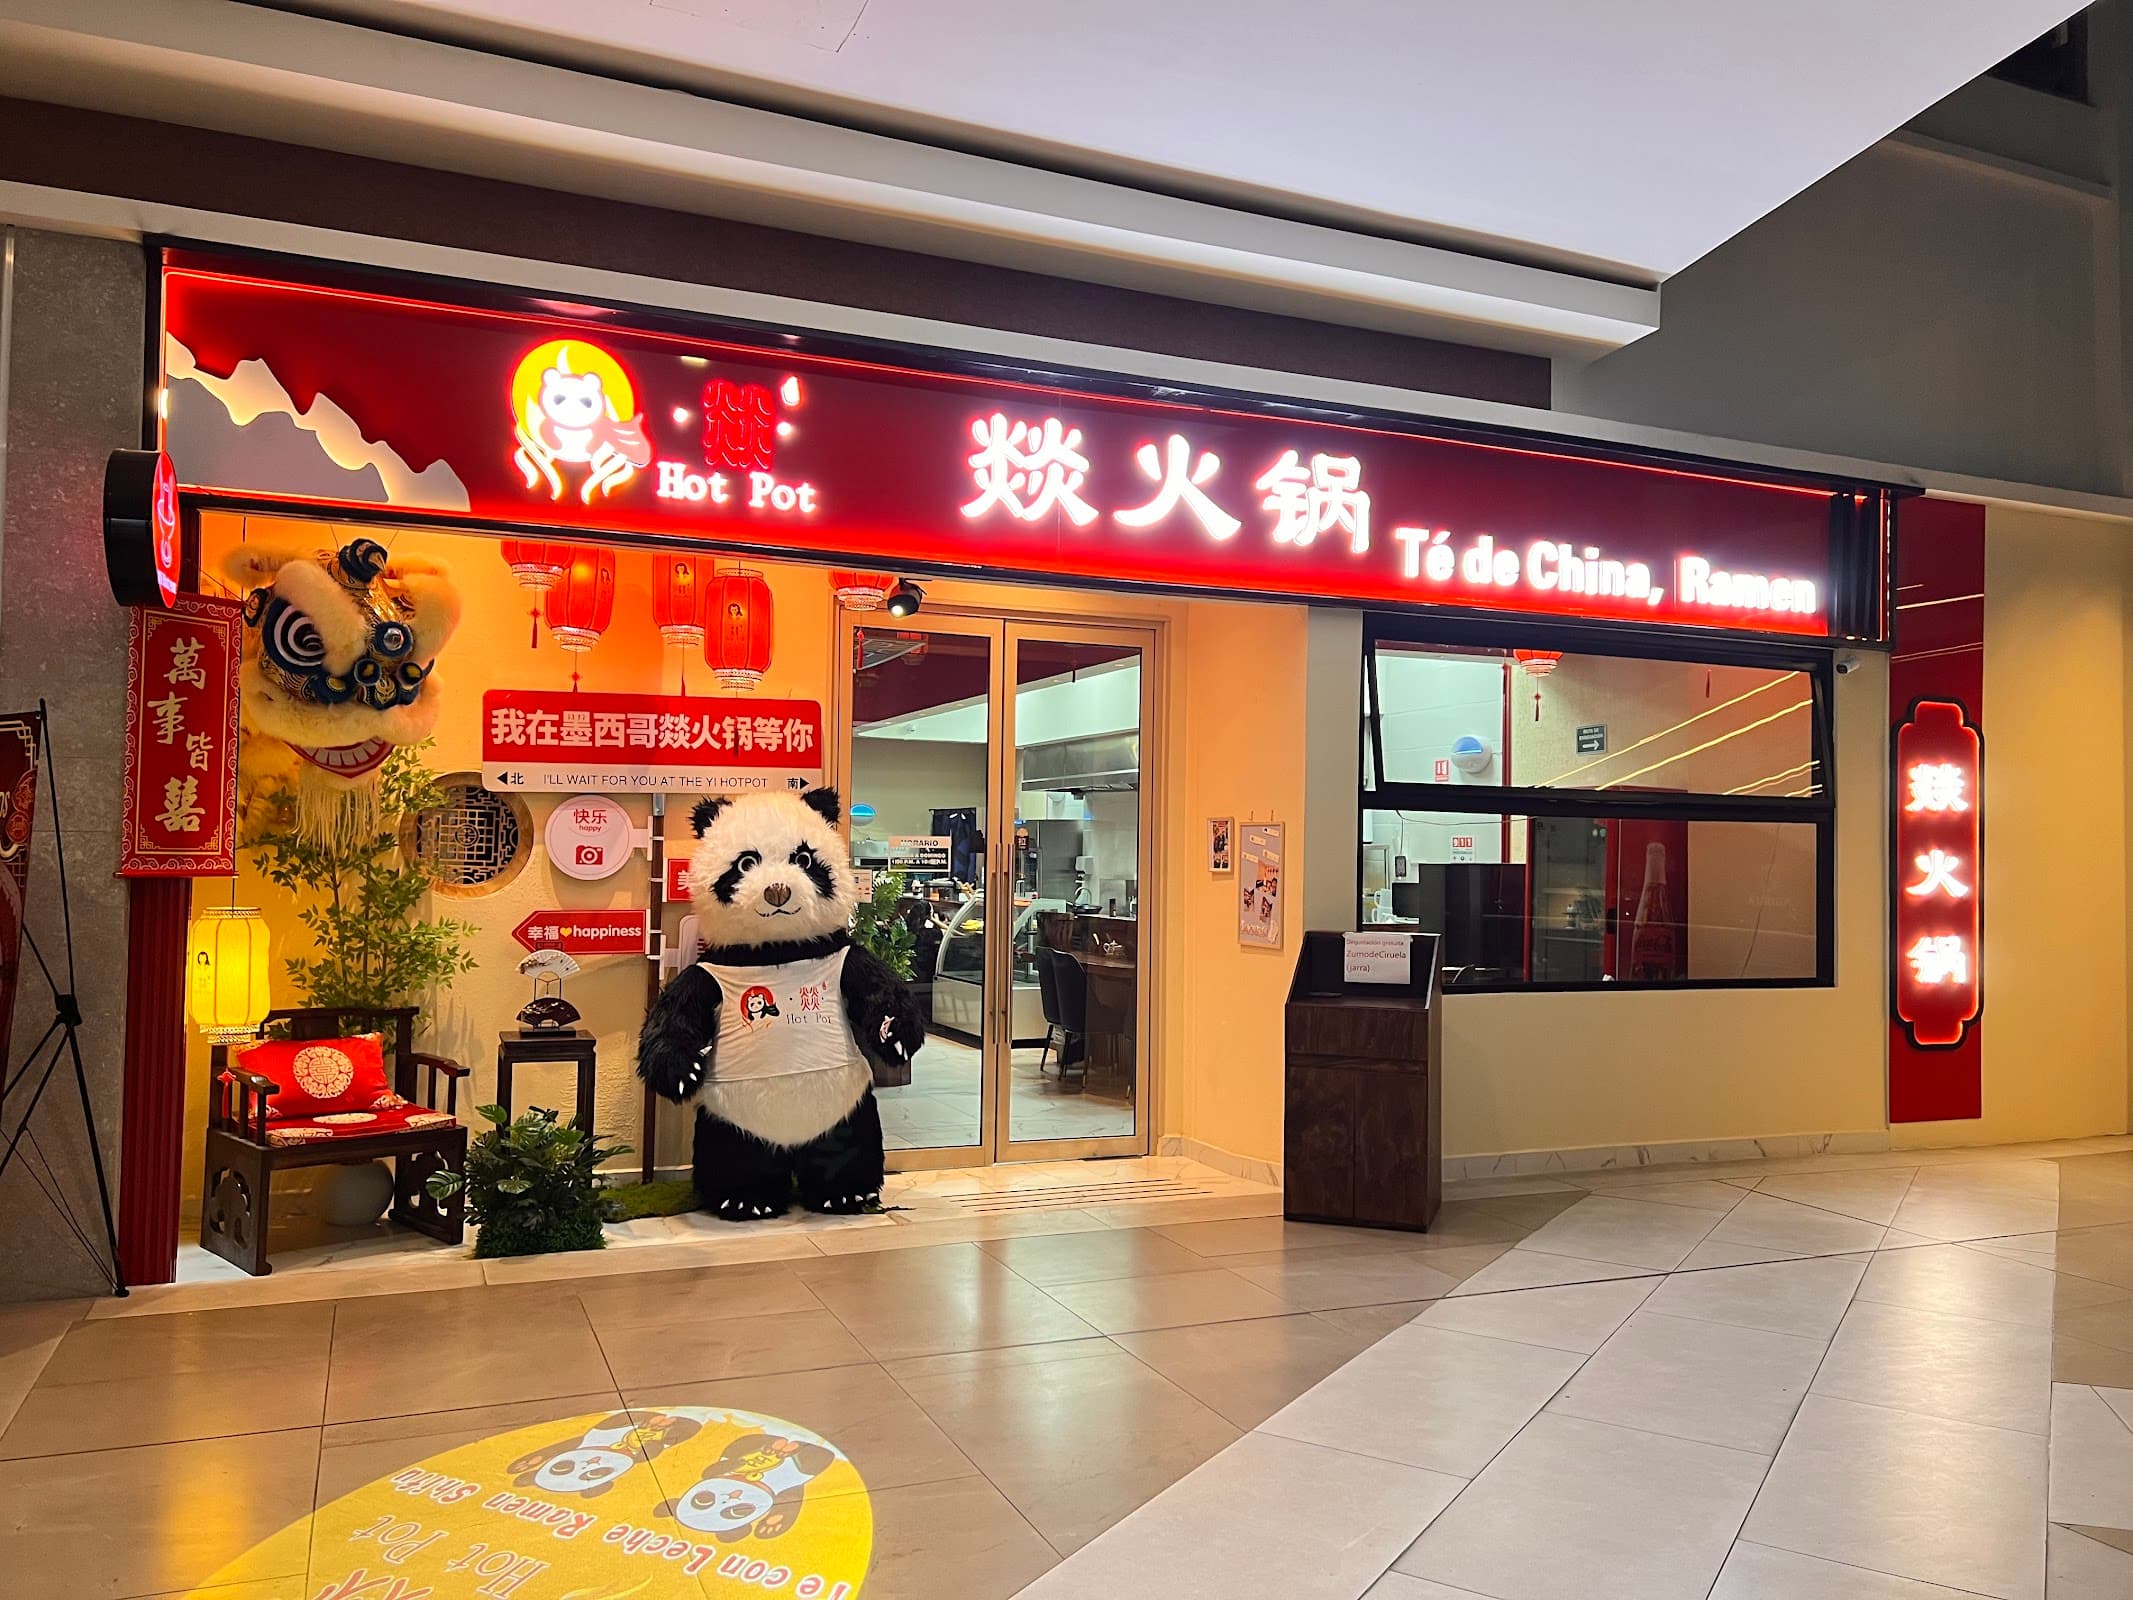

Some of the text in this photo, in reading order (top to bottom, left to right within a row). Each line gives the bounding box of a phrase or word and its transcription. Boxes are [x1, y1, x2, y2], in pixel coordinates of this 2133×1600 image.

[656, 461, 817, 513] Hot Pot
[960, 412, 1371, 554] 燚火锅
[1395, 526, 1818, 614] Té de China, Ramen
[490, 708, 815, 754] 我在墨西哥燚火锅等你
[510, 773, 525, 786] 北
[543, 774, 769, 789] I'LL WAIT FOR YOU AT THE YI HOTPOT
[787, 777, 800, 790] 南
[573, 808, 608, 825] 快乐
[578, 824, 602, 833] happy
[528, 925, 560, 941] 幸福
[573, 925, 642, 940] happiness
[787, 1013, 808, 1025] Hot
[390, 1466, 481, 1505] Shifu
[482, 1491, 599, 1539] Ramen
[347, 1513, 451, 1565] Pot
[602, 1523, 717, 1576] Leche
[443, 1542, 553, 1600] Hot
[717, 1553, 792, 1589] con
